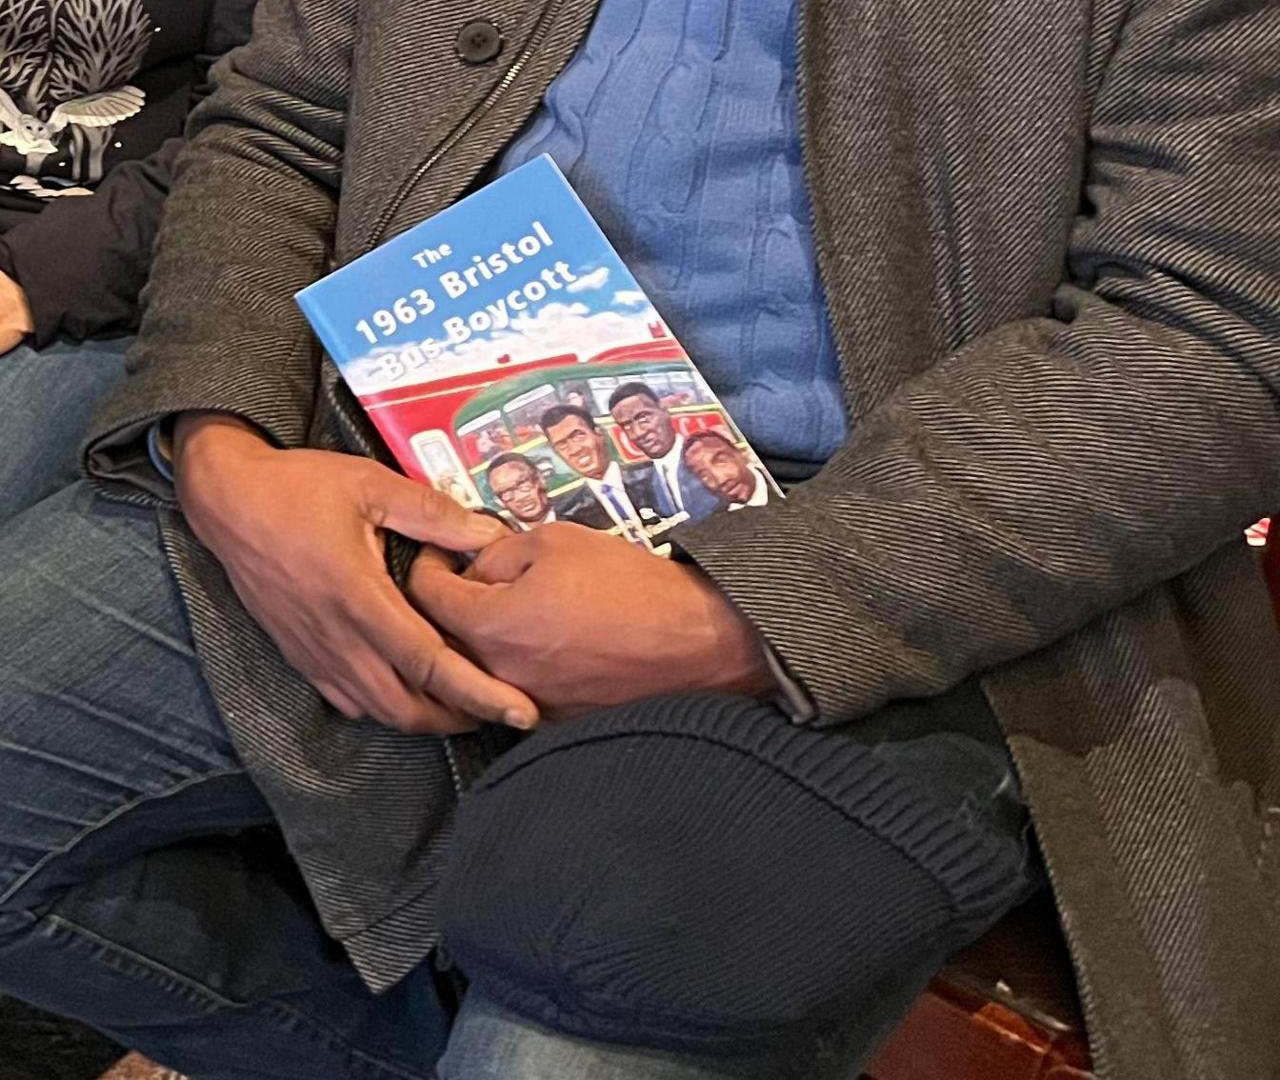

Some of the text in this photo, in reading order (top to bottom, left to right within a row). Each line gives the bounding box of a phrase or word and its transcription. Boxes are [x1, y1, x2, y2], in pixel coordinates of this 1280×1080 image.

[355, 220, 554, 345] 1963 Bristol
[411, 242, 453, 268] The
[376, 260, 578, 381] Bus Boycott
